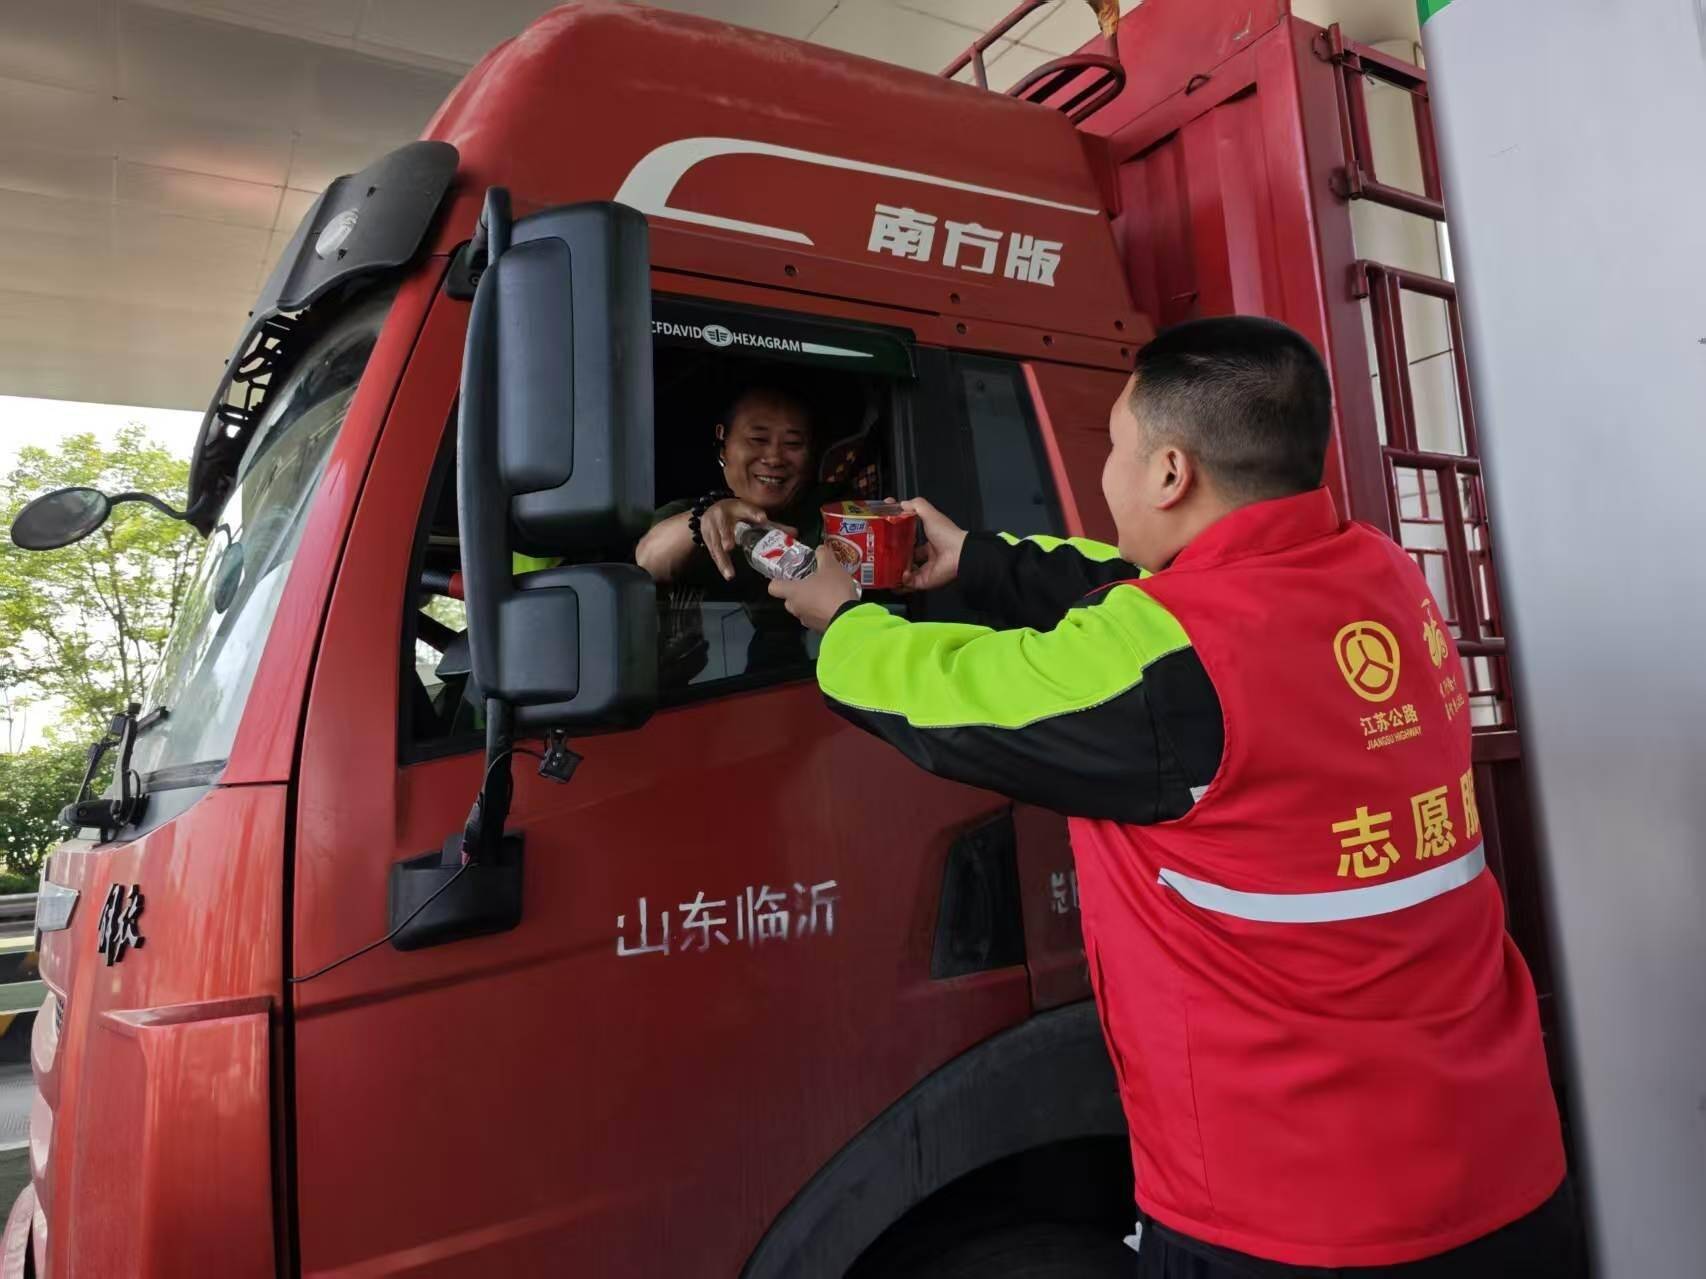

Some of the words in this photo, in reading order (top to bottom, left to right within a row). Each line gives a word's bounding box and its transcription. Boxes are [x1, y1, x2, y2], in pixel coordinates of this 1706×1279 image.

[867, 203, 1063, 287] 南方版
[733, 332, 801, 353] HEXAGRAM
[1360, 703, 1418, 737] 江苏公路
[616, 879, 838, 956] 山东临沂
